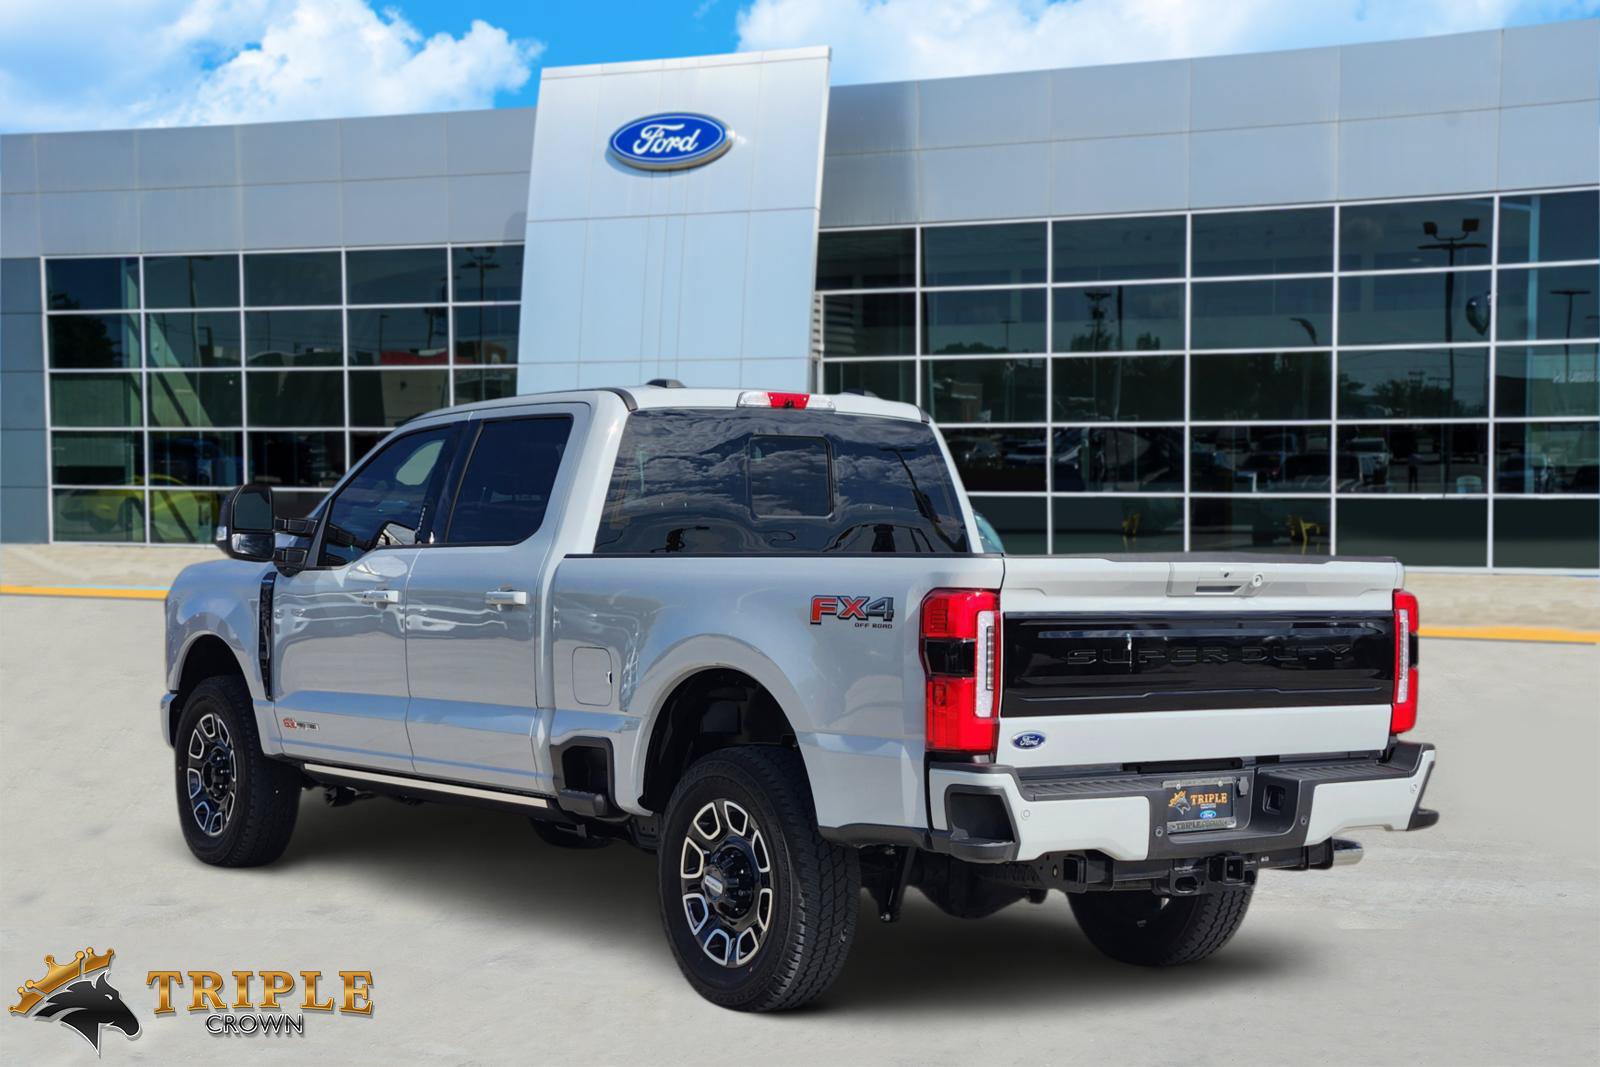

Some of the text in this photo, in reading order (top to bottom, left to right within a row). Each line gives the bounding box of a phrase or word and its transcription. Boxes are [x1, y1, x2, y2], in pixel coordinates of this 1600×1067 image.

[632, 123, 702, 155] Ford
[810, 594, 894, 625] FX4
[1019, 735, 1040, 747] Ford
[1190, 792, 1228, 806] TRIPLE
